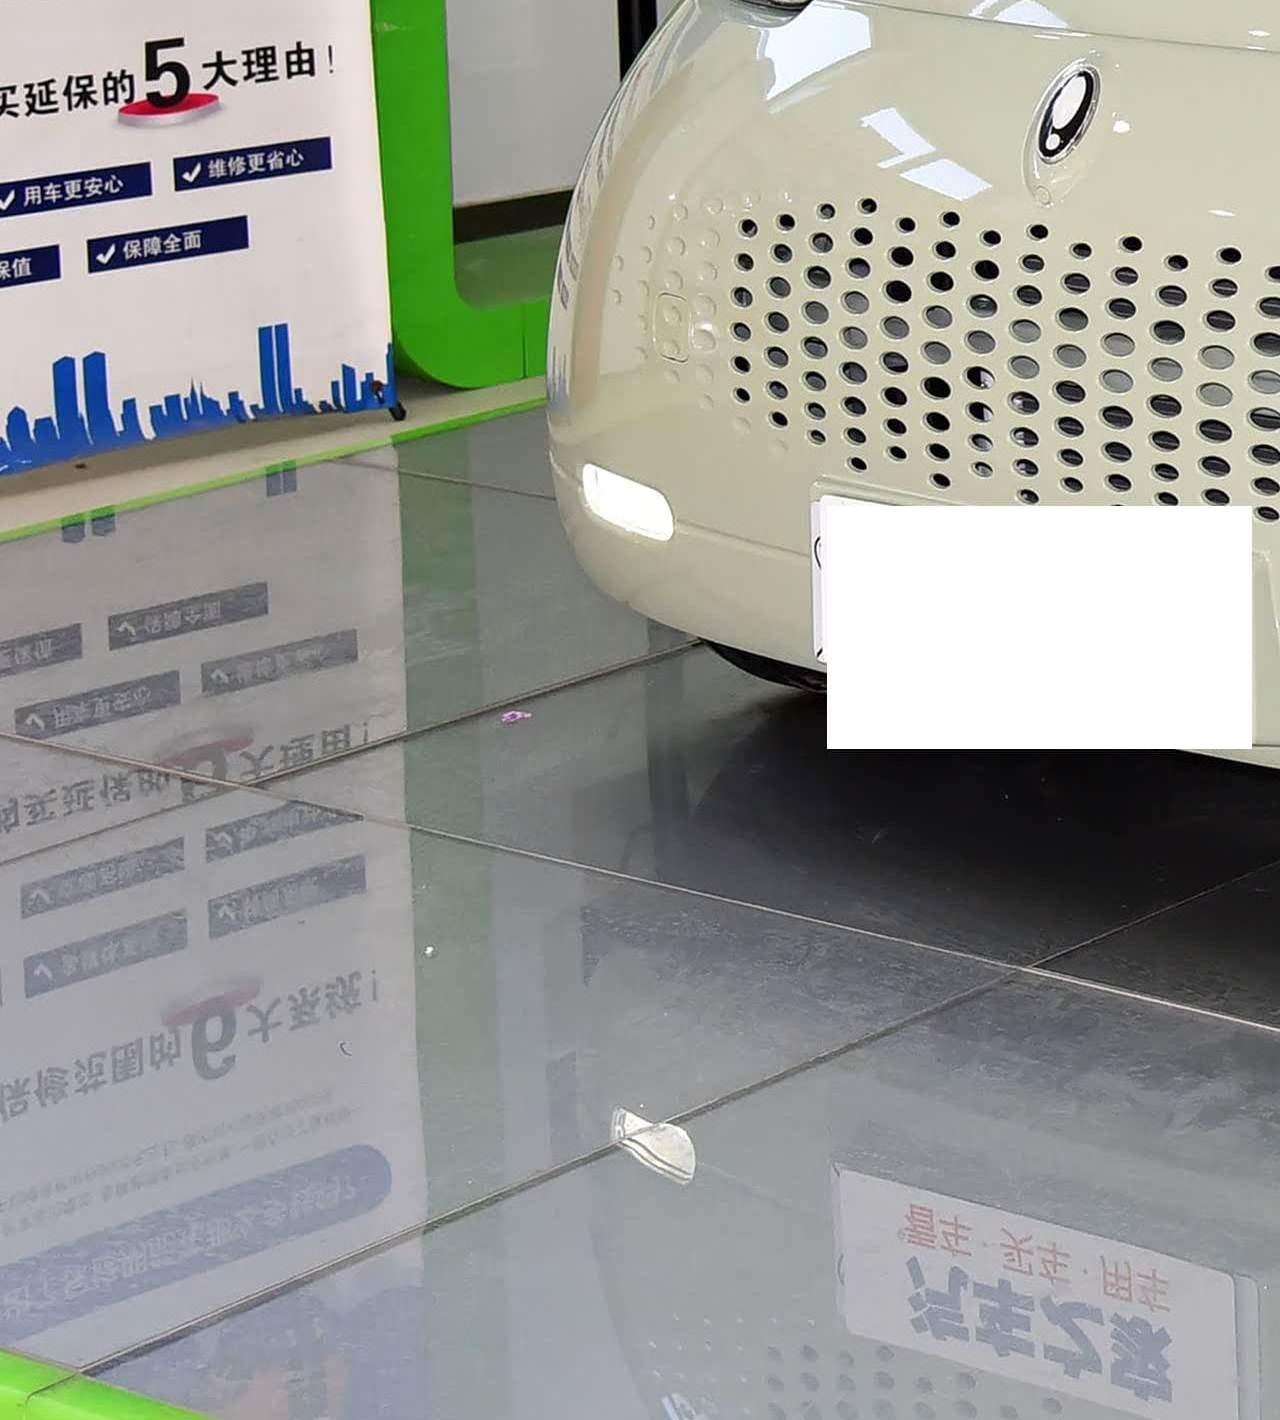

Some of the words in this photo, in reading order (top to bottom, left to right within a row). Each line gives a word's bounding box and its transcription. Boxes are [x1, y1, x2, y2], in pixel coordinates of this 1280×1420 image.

[207, 149, 304, 179] 维修更省心
[23, 175, 123, 207] 用车更安心
[122, 230, 202, 261] 保障全面
